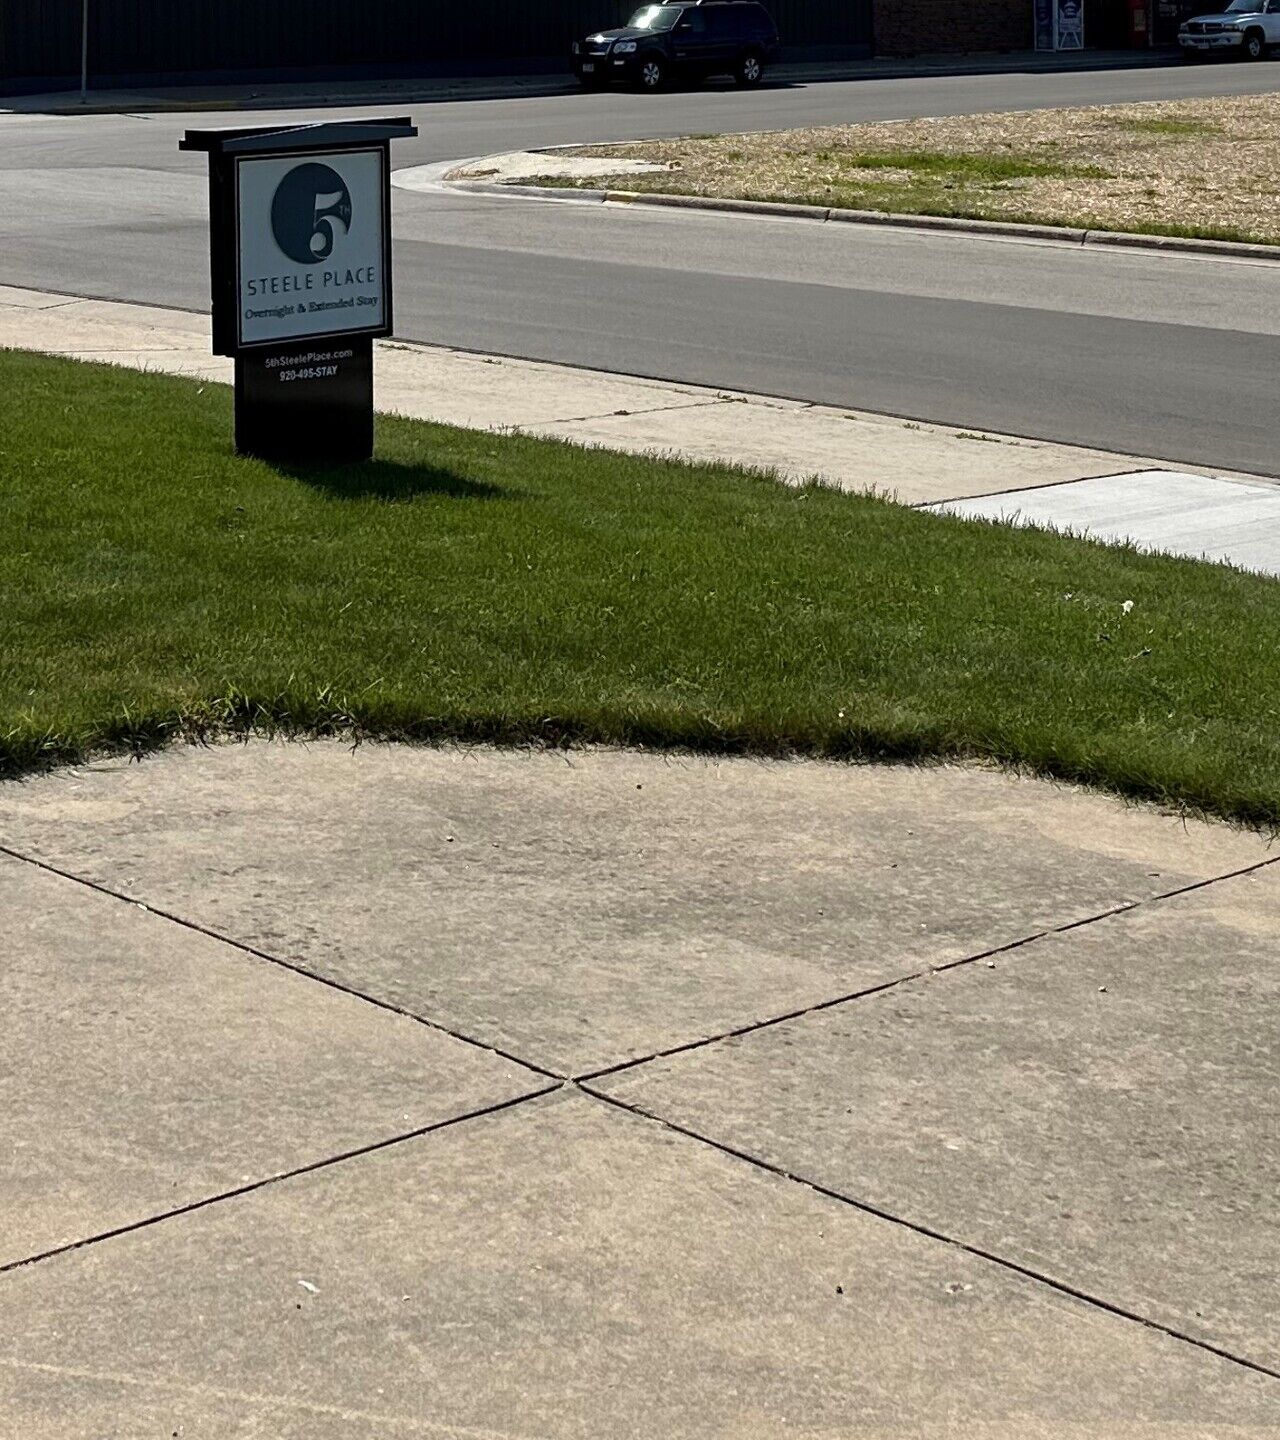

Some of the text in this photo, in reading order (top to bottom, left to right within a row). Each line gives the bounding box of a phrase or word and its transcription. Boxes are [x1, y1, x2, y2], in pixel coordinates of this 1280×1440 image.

[247, 266, 376, 296] STEELE PLACE
[245, 295, 379, 320] Overnight & Extended Stay
